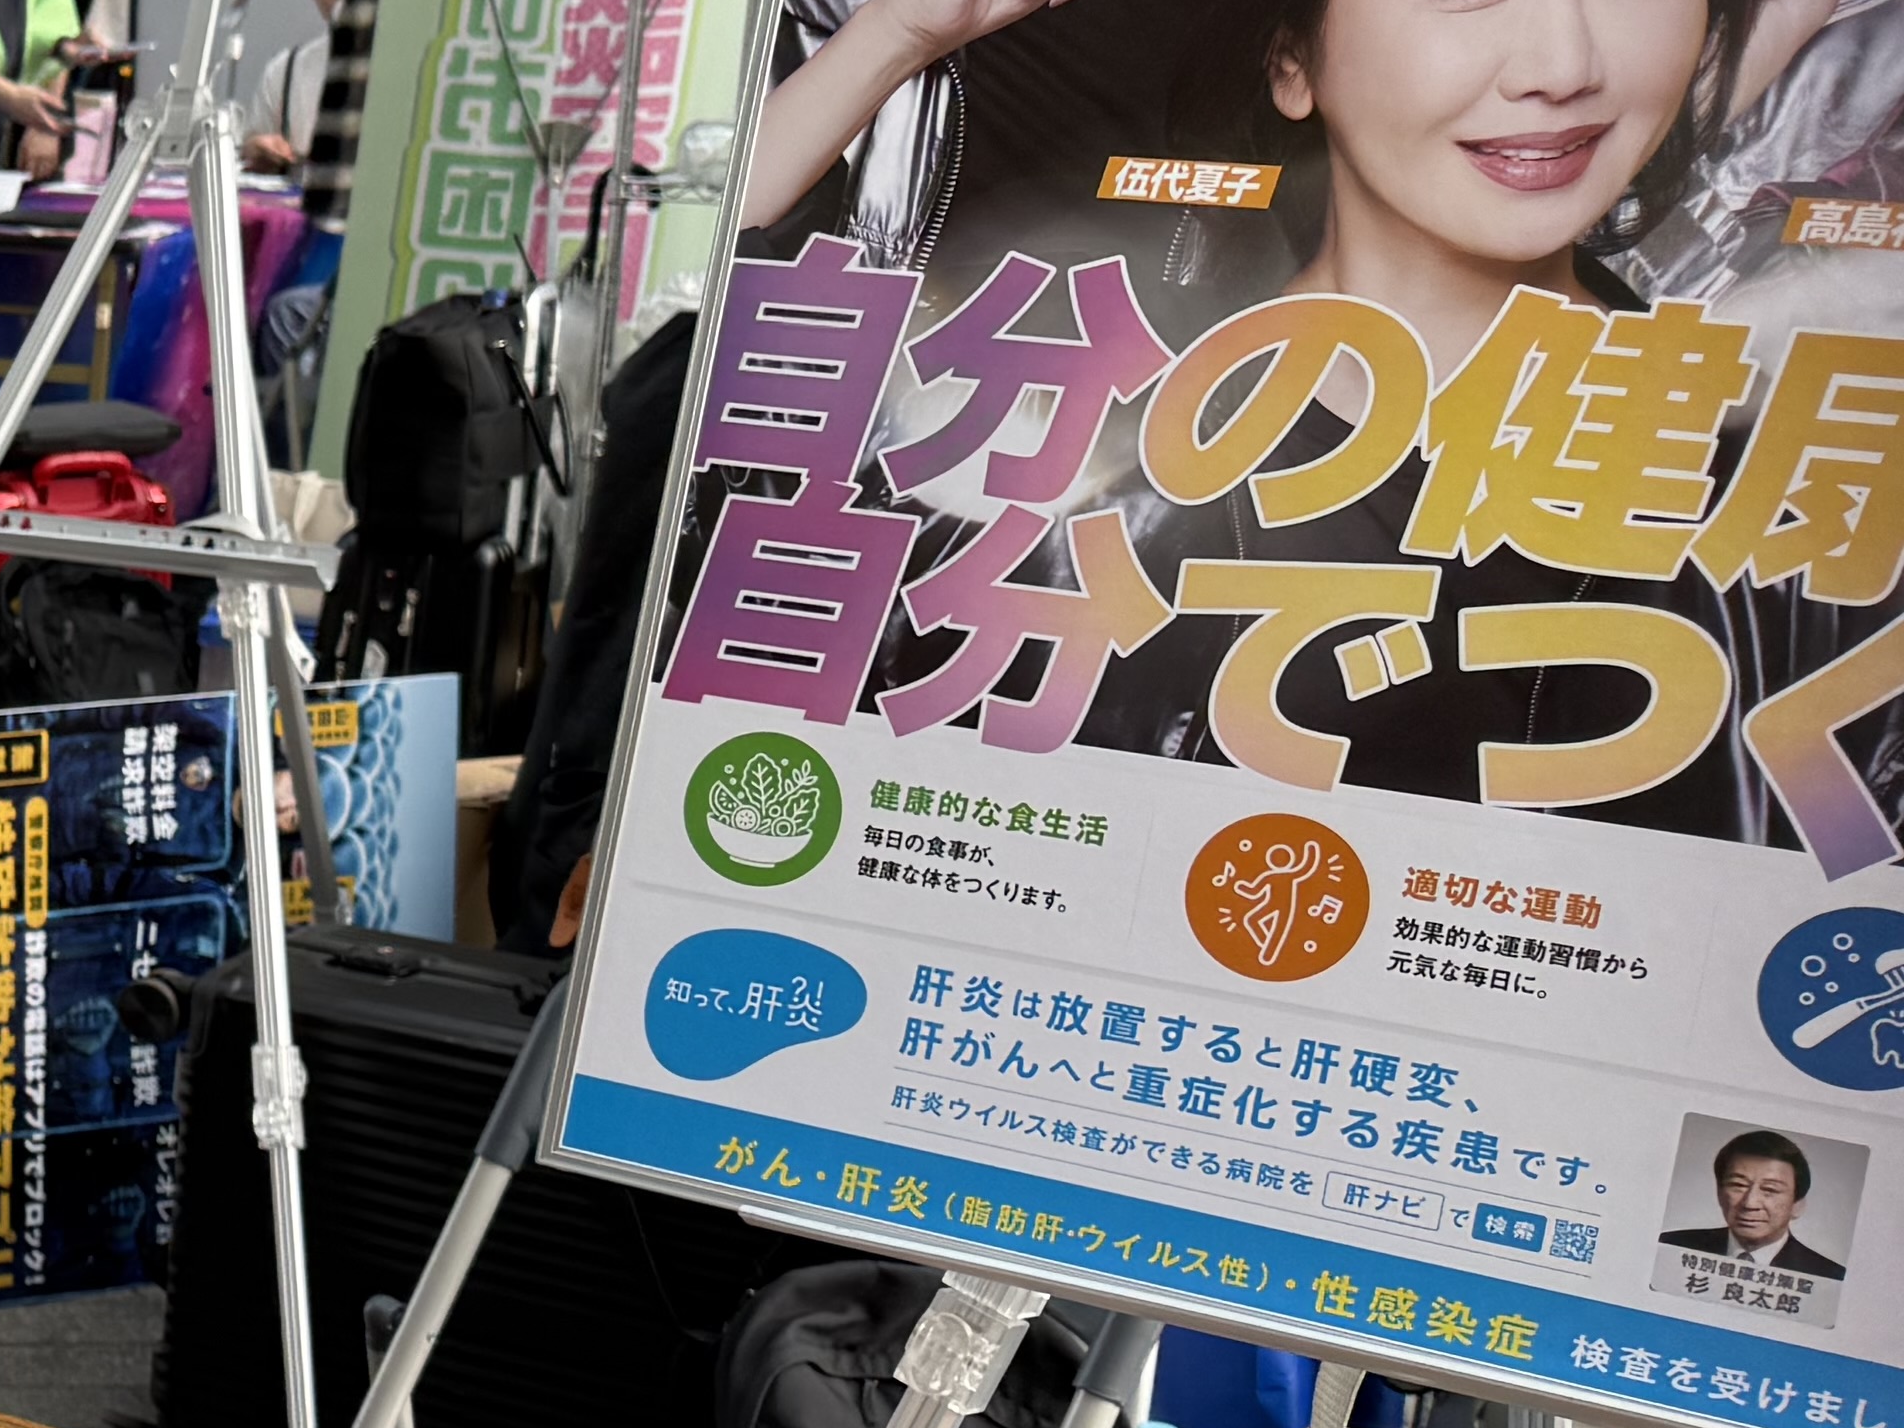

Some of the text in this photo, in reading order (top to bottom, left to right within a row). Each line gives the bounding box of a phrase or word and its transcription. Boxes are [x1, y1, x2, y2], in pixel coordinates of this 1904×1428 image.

[1112, 157, 1262, 204] 伍代夏子
[691, 231, 1904, 608] 自分の健康
[660, 475, 1904, 884] 自分でつく
[150, 723, 179, 843] 架空料金
[868, 778, 1110, 849] 健康的な食生活
[856, 854, 1068, 916] 健康な体をつくります。
[863, 824, 997, 869] 毎日の食事が、
[1401, 866, 1604, 930] 適切な運動
[1386, 948, 1549, 1001] 元気な毎日に。
[1392, 915, 1650, 982] 効果的な運動習慣から
[130, 919, 161, 1108] ニセ詐欺
[907, 962, 1486, 1116] 肝炎は放置すると肝硬変、
[890, 1083, 1315, 1196] 肝炎ウイルス検査ができる病院を
[1342, 1181, 1428, 1222] 肝ナビ
[897, 1016, 1610, 1197] 肝がんへと重症化する疾患です。
